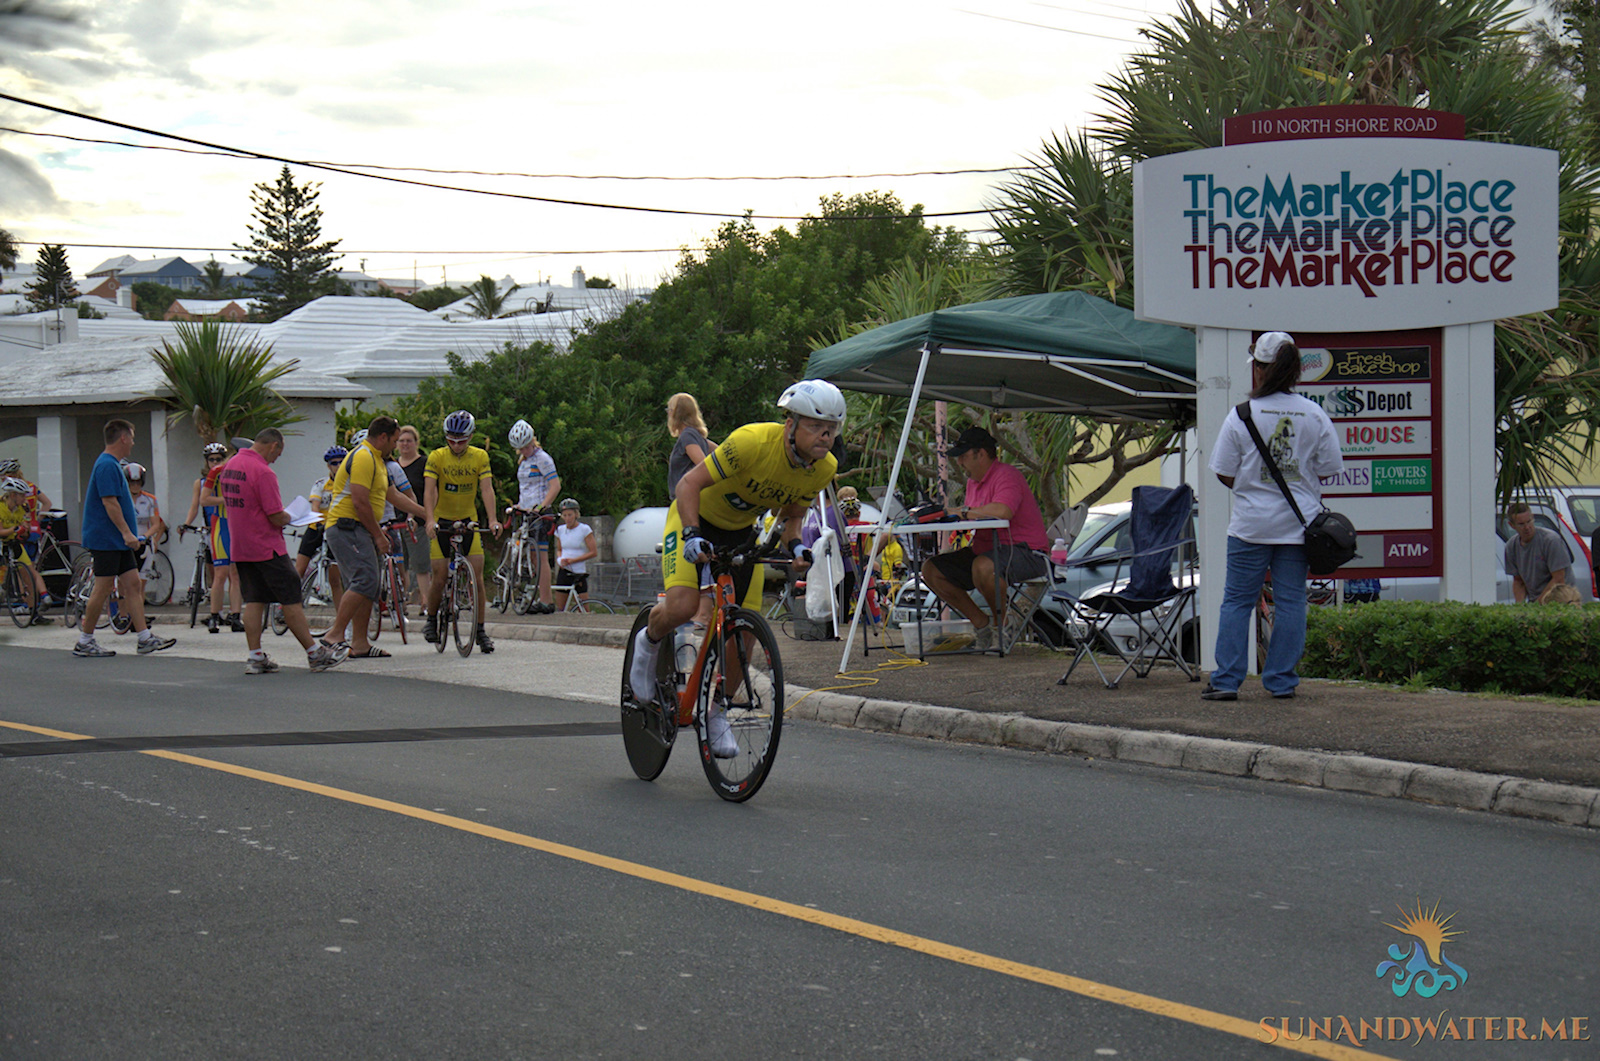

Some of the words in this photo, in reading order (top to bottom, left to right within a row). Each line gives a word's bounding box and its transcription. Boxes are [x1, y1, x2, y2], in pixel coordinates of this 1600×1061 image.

[1251, 119, 1272, 135] 110
[1276, 118, 1330, 134] NORTH
[1335, 117, 1389, 133] SHORE
[1393, 117, 1438, 132] ROAD
[1347, 353, 1392, 365] Fresh
[1367, 390, 1412, 413] Depot
[1346, 426, 1415, 445] HOUSE
[443, 467, 476, 476] WORKS
[1374, 466, 1427, 479] FLOWERS
[762, 478, 801, 495] BICYCLE
[1389, 478, 1426, 486] THINGS
[1388, 543, 1421, 557] ATM
